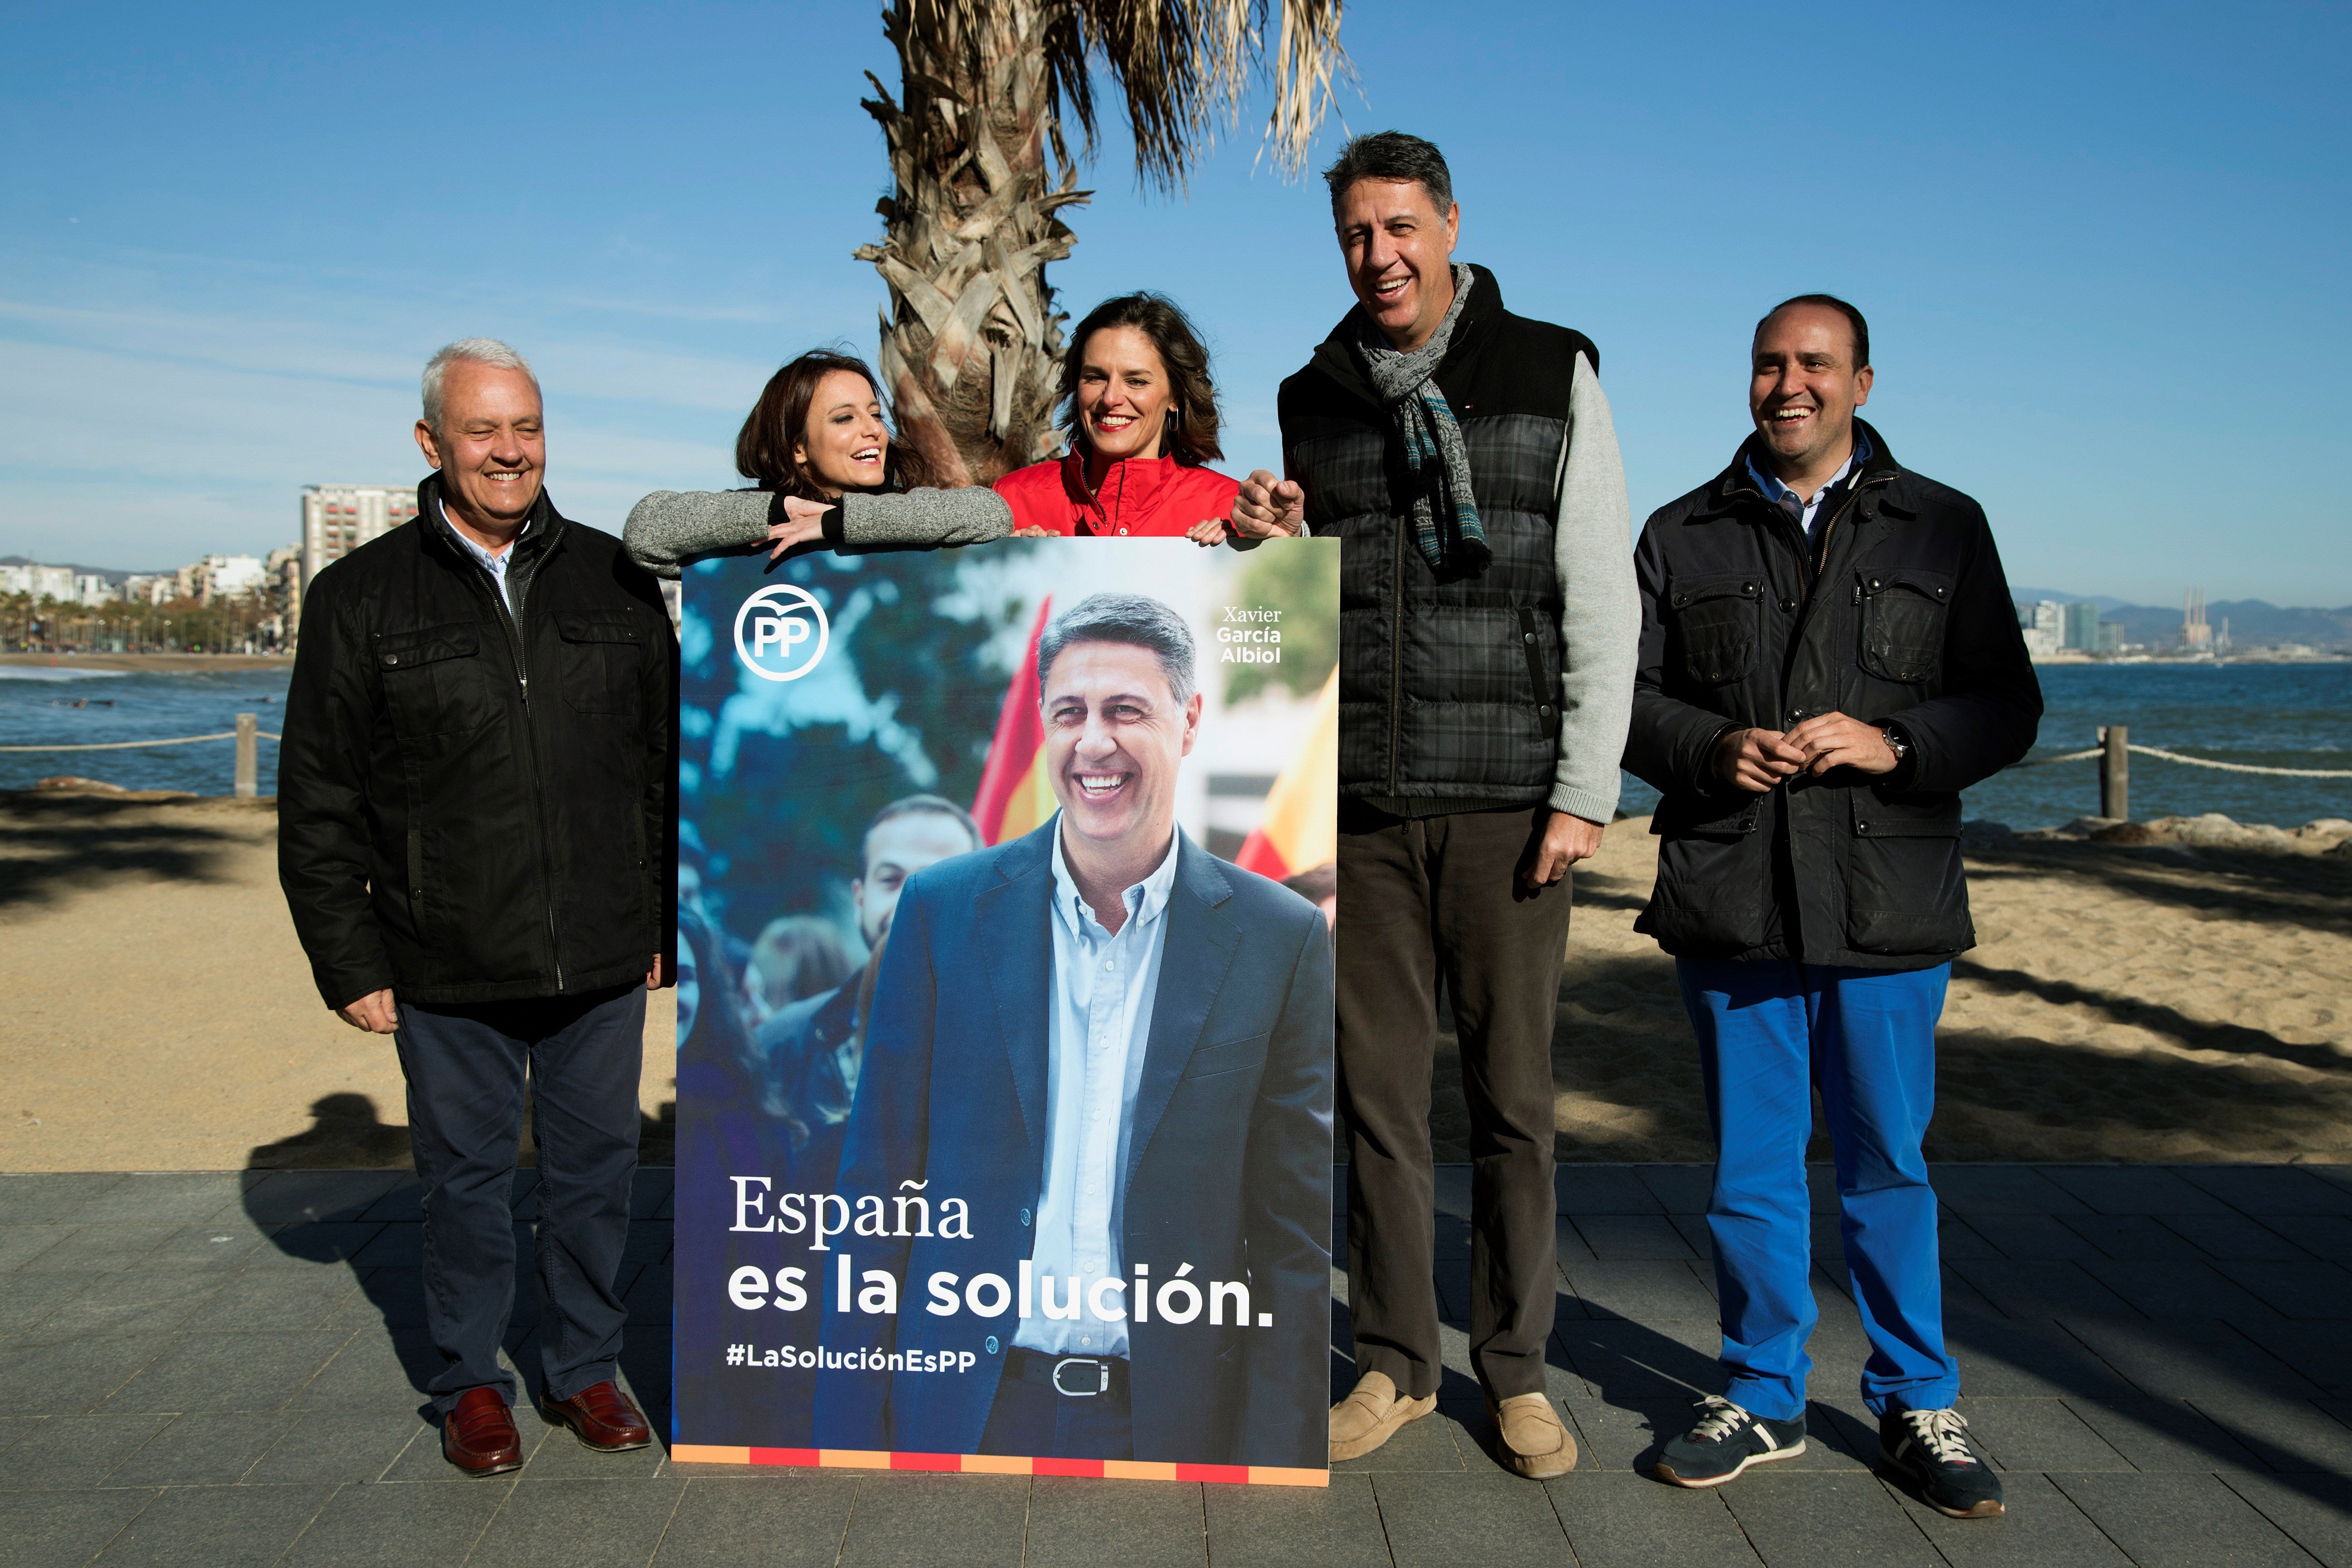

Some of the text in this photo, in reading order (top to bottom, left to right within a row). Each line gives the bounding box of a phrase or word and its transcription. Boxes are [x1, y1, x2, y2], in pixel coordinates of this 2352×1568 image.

[1222, 605, 1282, 623] Xavier
[754, 616, 811, 658] PP
[1216, 626, 1281, 643] García
[1220, 647, 1281, 663] Albiol
[729, 1175, 974, 1251] España
[728, 1253, 1273, 1327] es la solución.
[726, 1343, 976, 1373] #LaSoluciónEsPP
